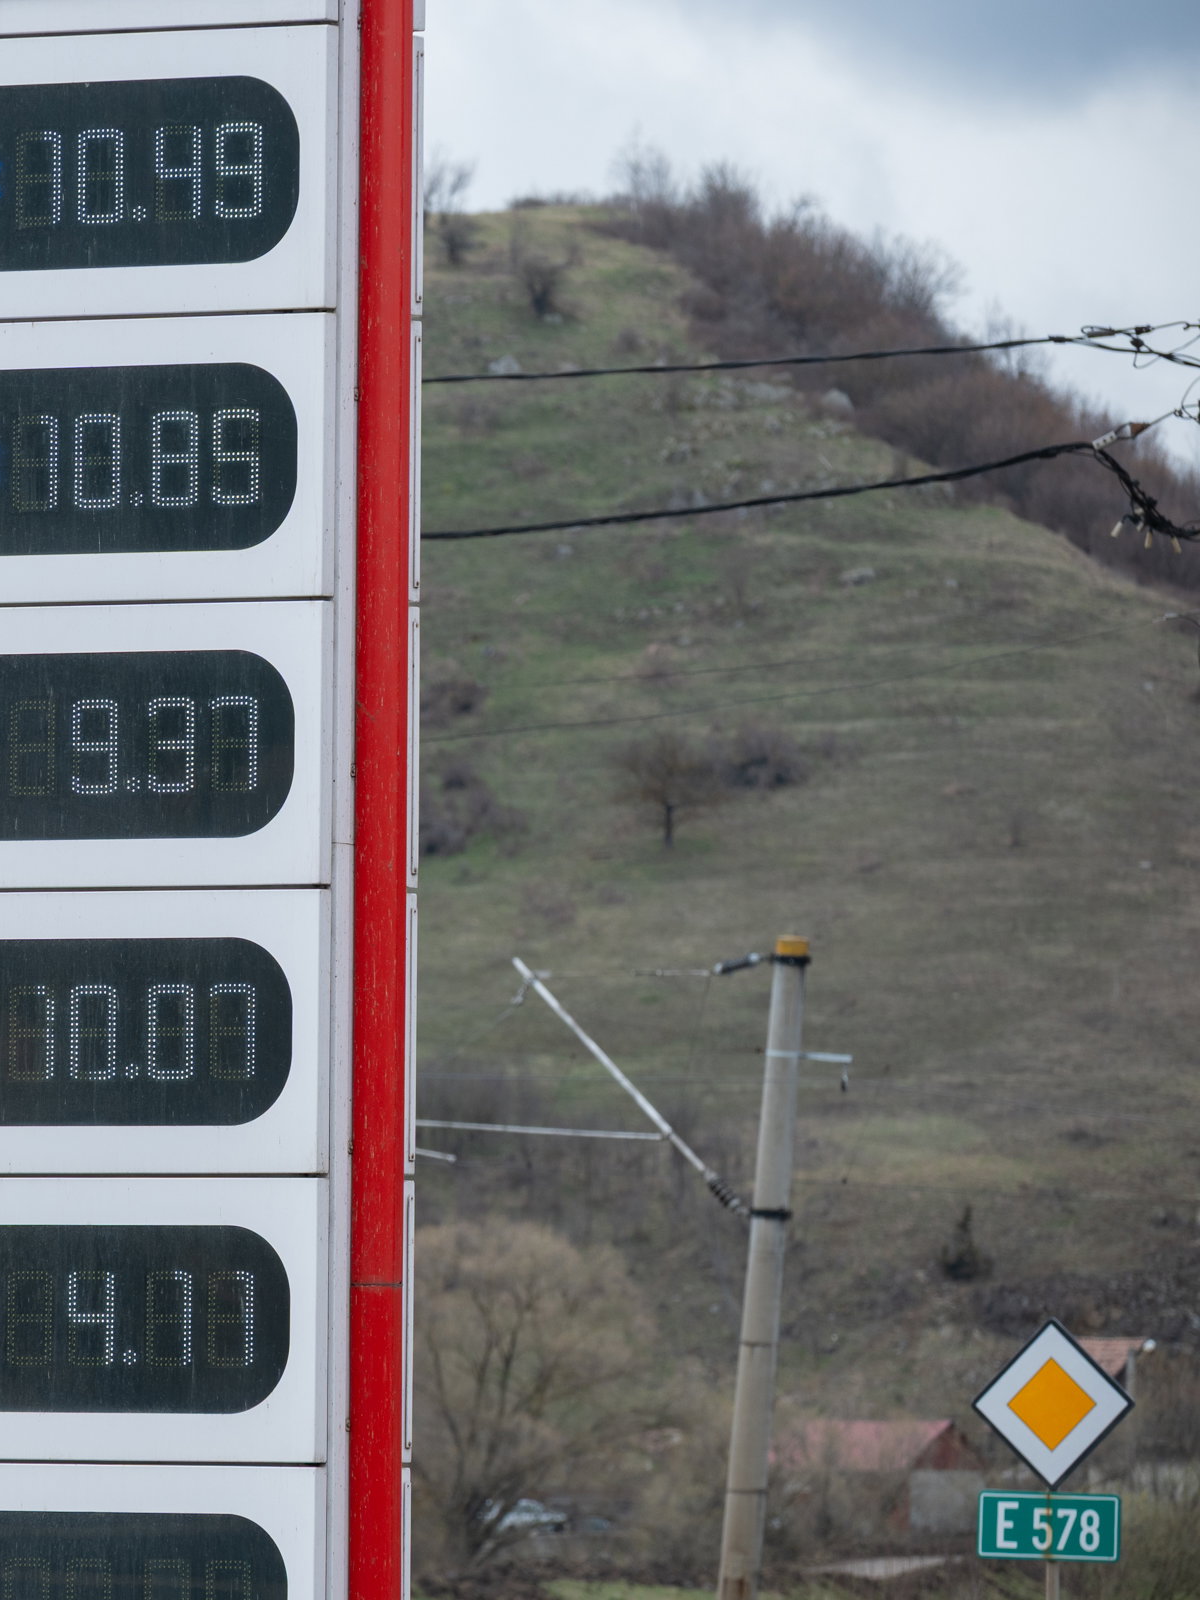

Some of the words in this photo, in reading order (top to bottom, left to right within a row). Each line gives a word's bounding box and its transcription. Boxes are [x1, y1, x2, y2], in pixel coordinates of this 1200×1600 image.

[43, 122, 263, 225] 10.49
[40, 408, 260, 509] 10.85
[71, 695, 258, 795] 9.37
[38, 983, 256, 1081] 10.07
[996, 1501, 1019, 1549] E
[1032, 1507, 1100, 1552] 578
